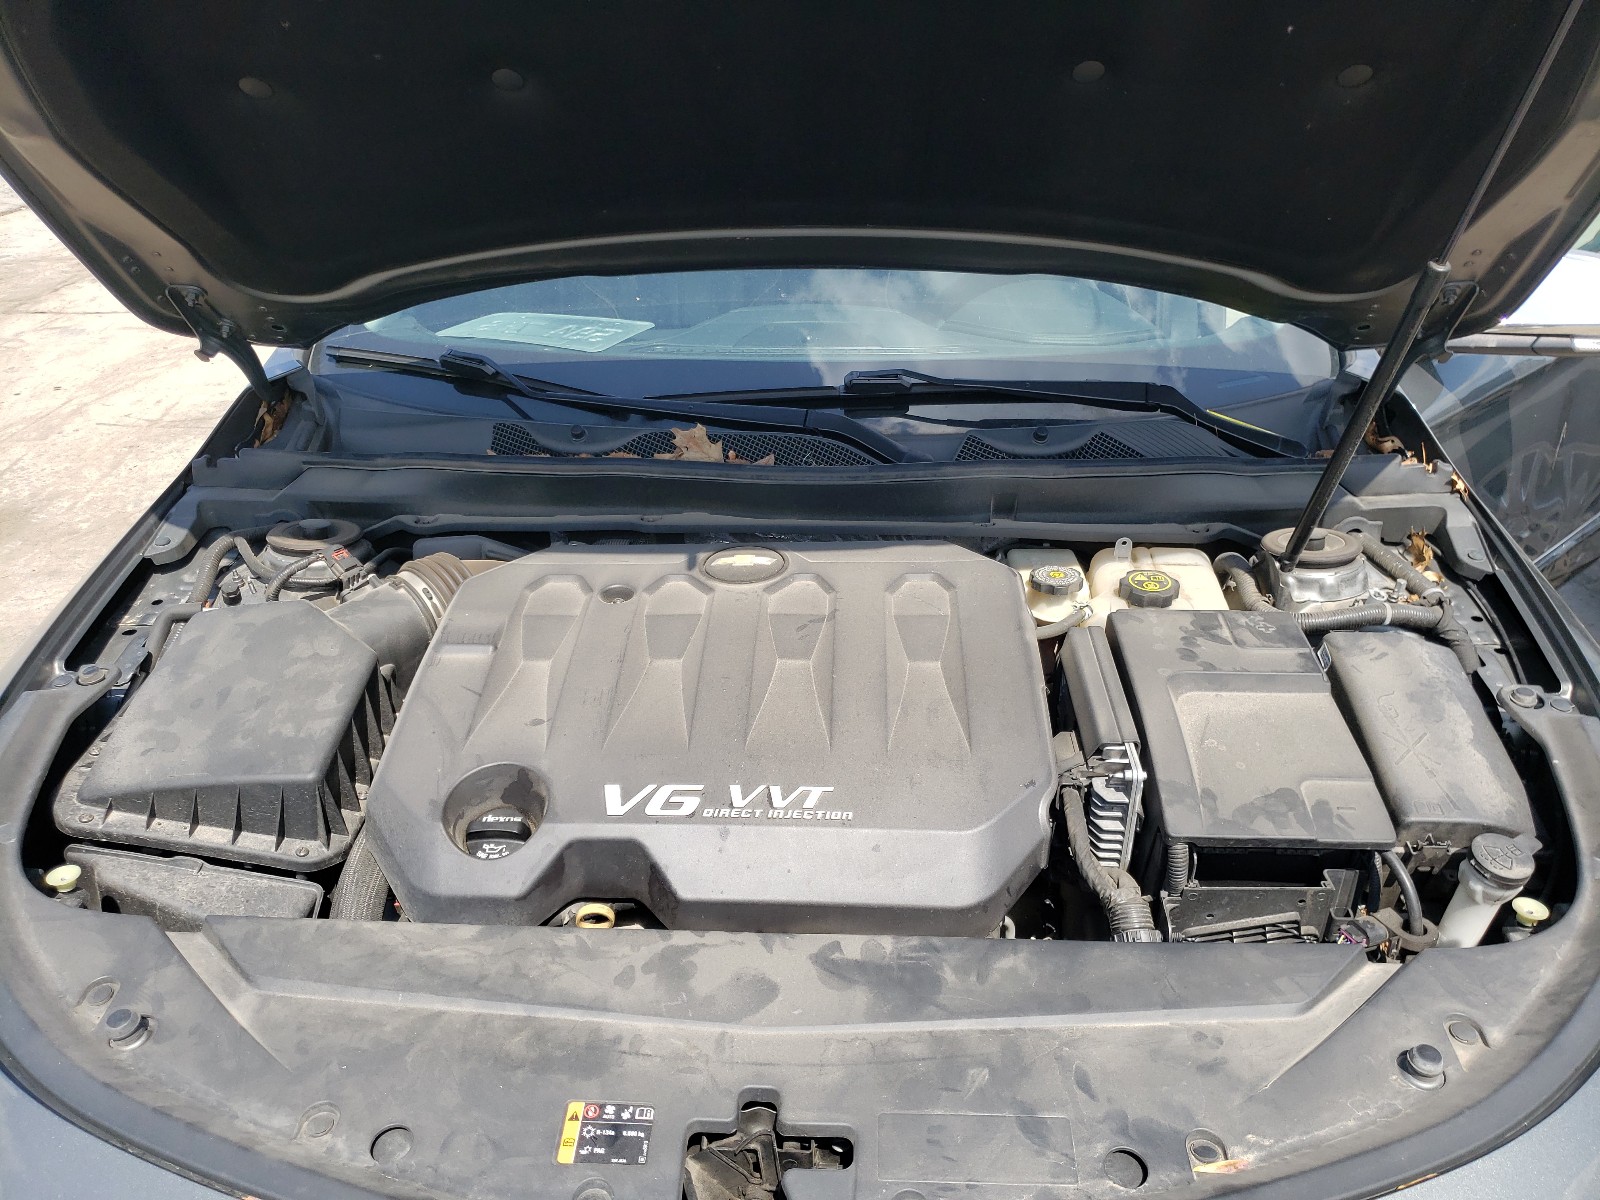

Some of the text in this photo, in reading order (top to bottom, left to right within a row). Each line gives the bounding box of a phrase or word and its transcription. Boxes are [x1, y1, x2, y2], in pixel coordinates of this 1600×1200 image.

[604, 784, 834, 816] V6 VVT
[702, 808, 853, 820] DIRECT INJECTION
